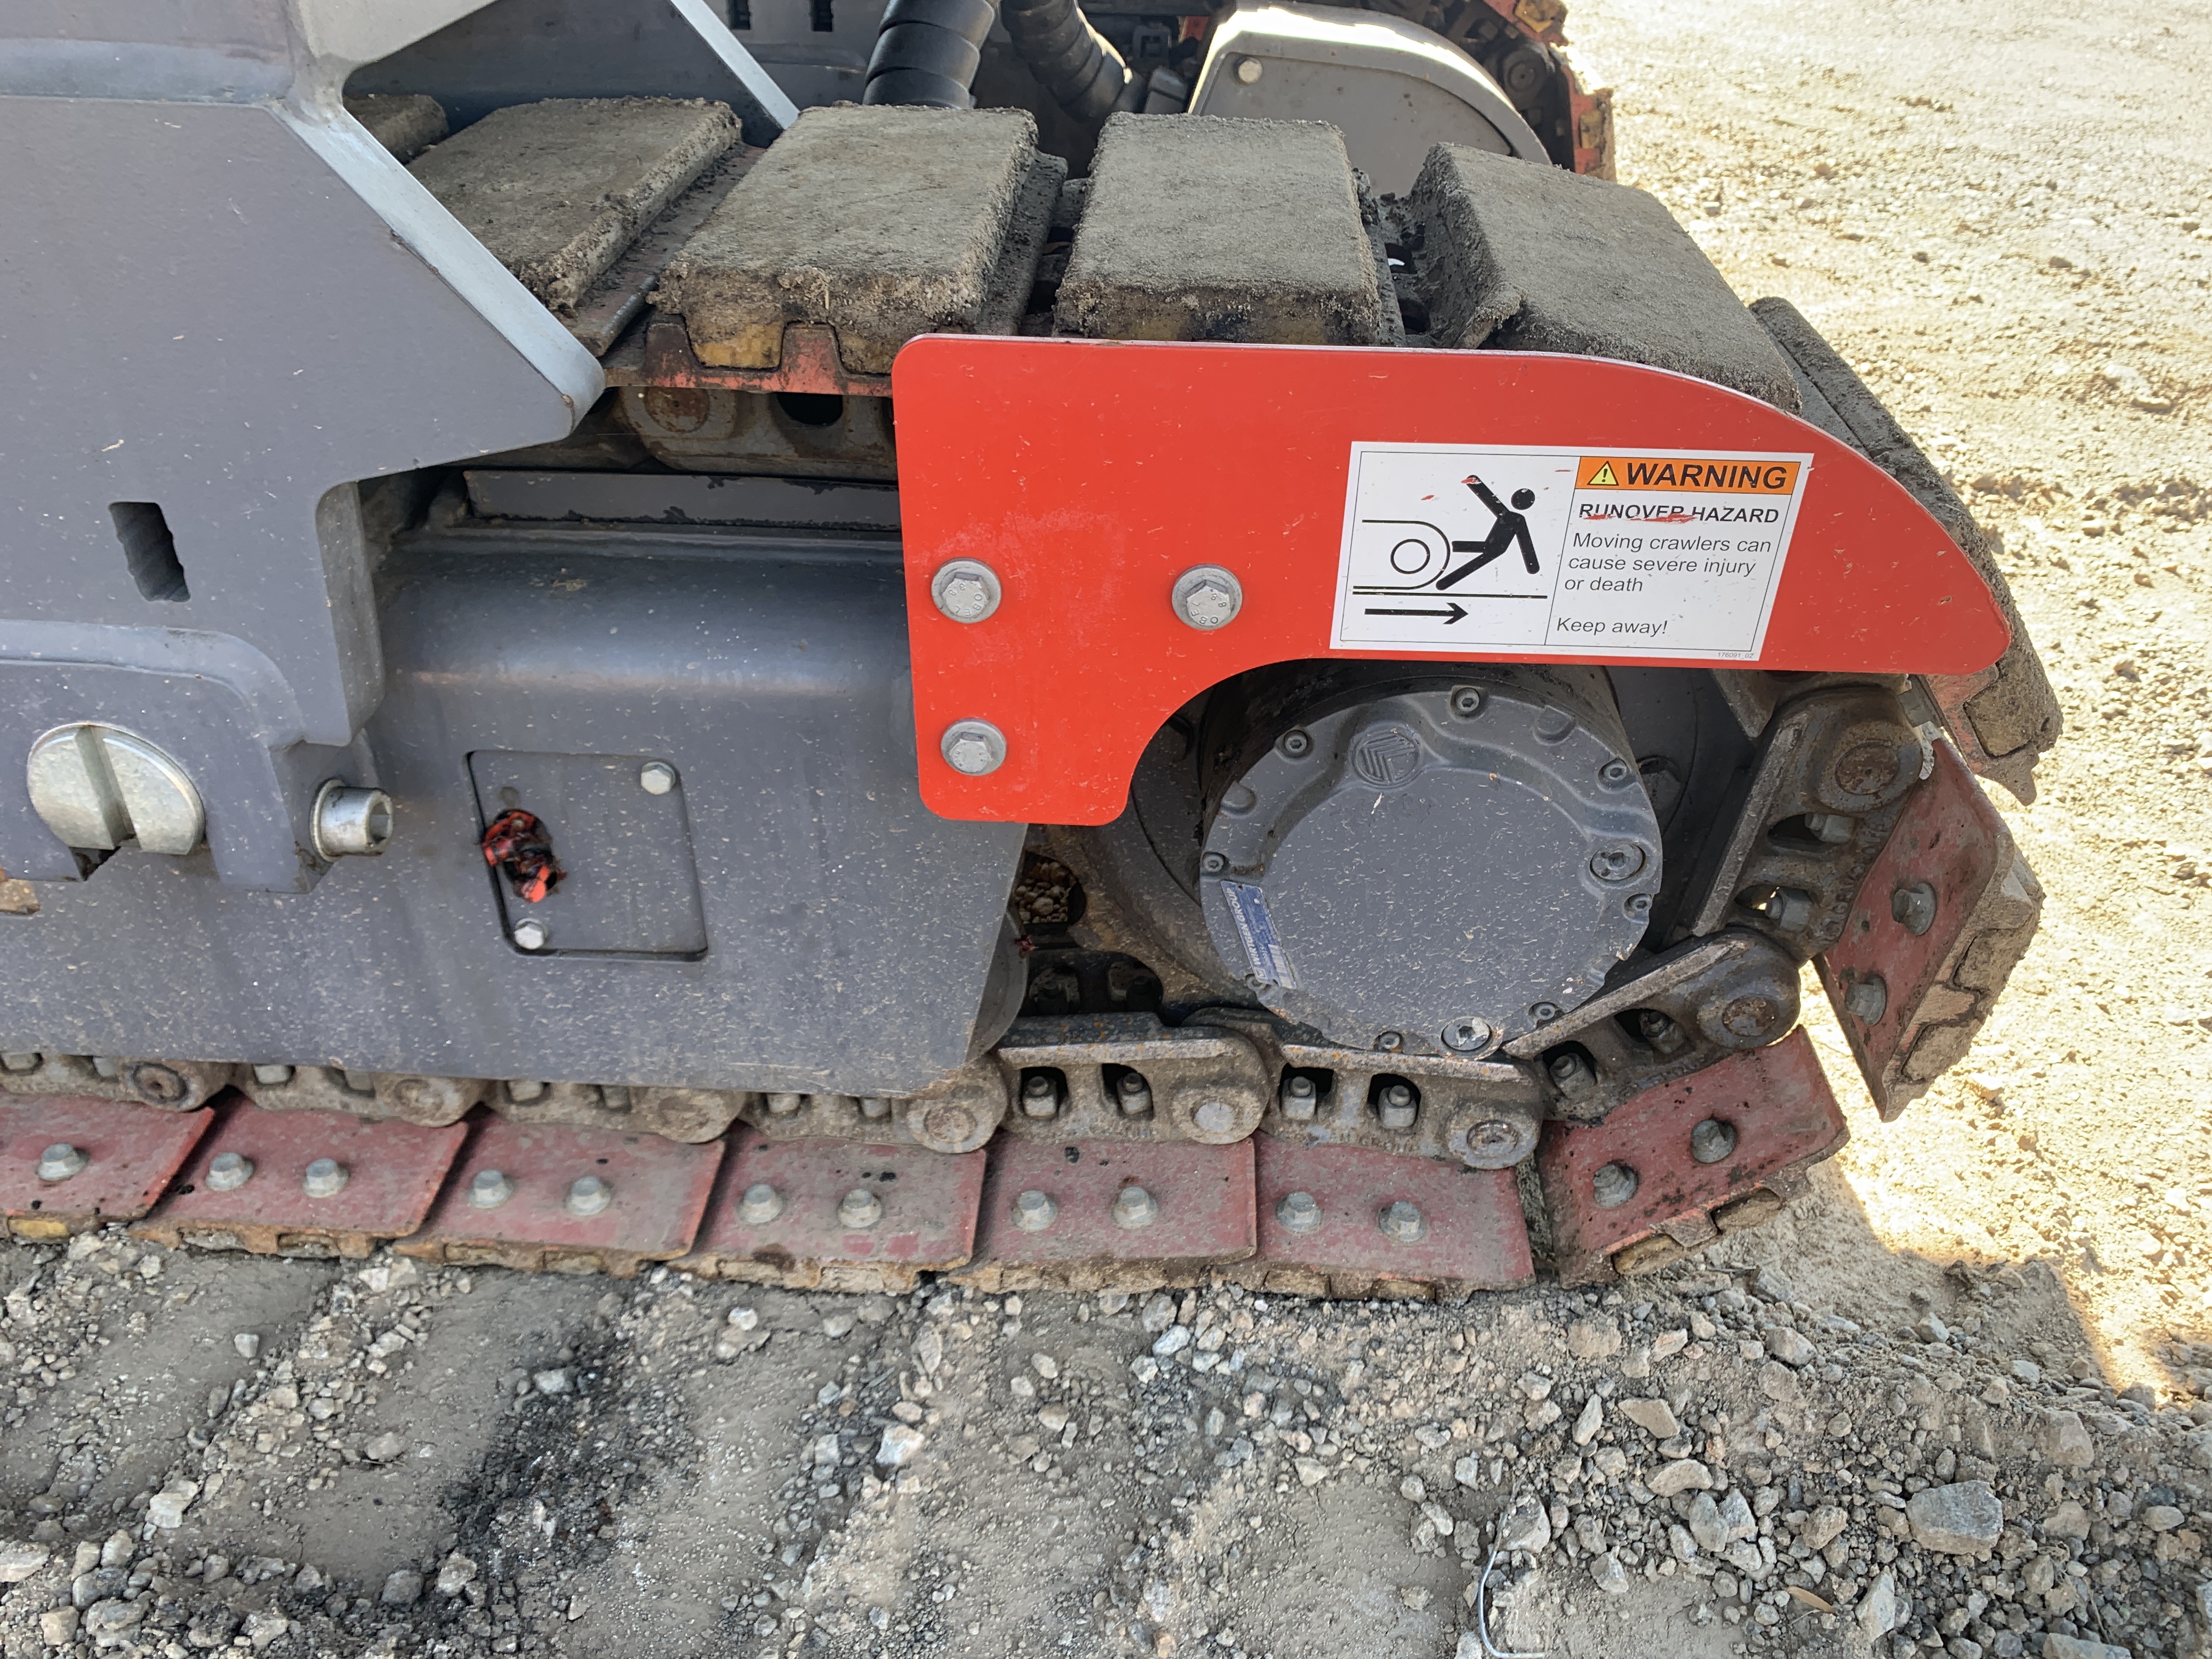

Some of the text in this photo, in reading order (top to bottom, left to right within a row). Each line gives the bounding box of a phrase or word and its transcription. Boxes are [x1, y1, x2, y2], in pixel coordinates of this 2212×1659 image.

[1627, 462, 1787, 489] WARNING
[1579, 504, 1779, 523] RUNOVER HAZARD
[1573, 532, 1771, 552] Moving crawlers can
[1568, 557, 1756, 577] cause severe injury
[1564, 577, 1643, 592] or death
[1556, 617, 1668, 637] Keep away!
[1227, 887, 1245, 922] GROUP
[1242, 923, 1261, 966] WIRTGEN
